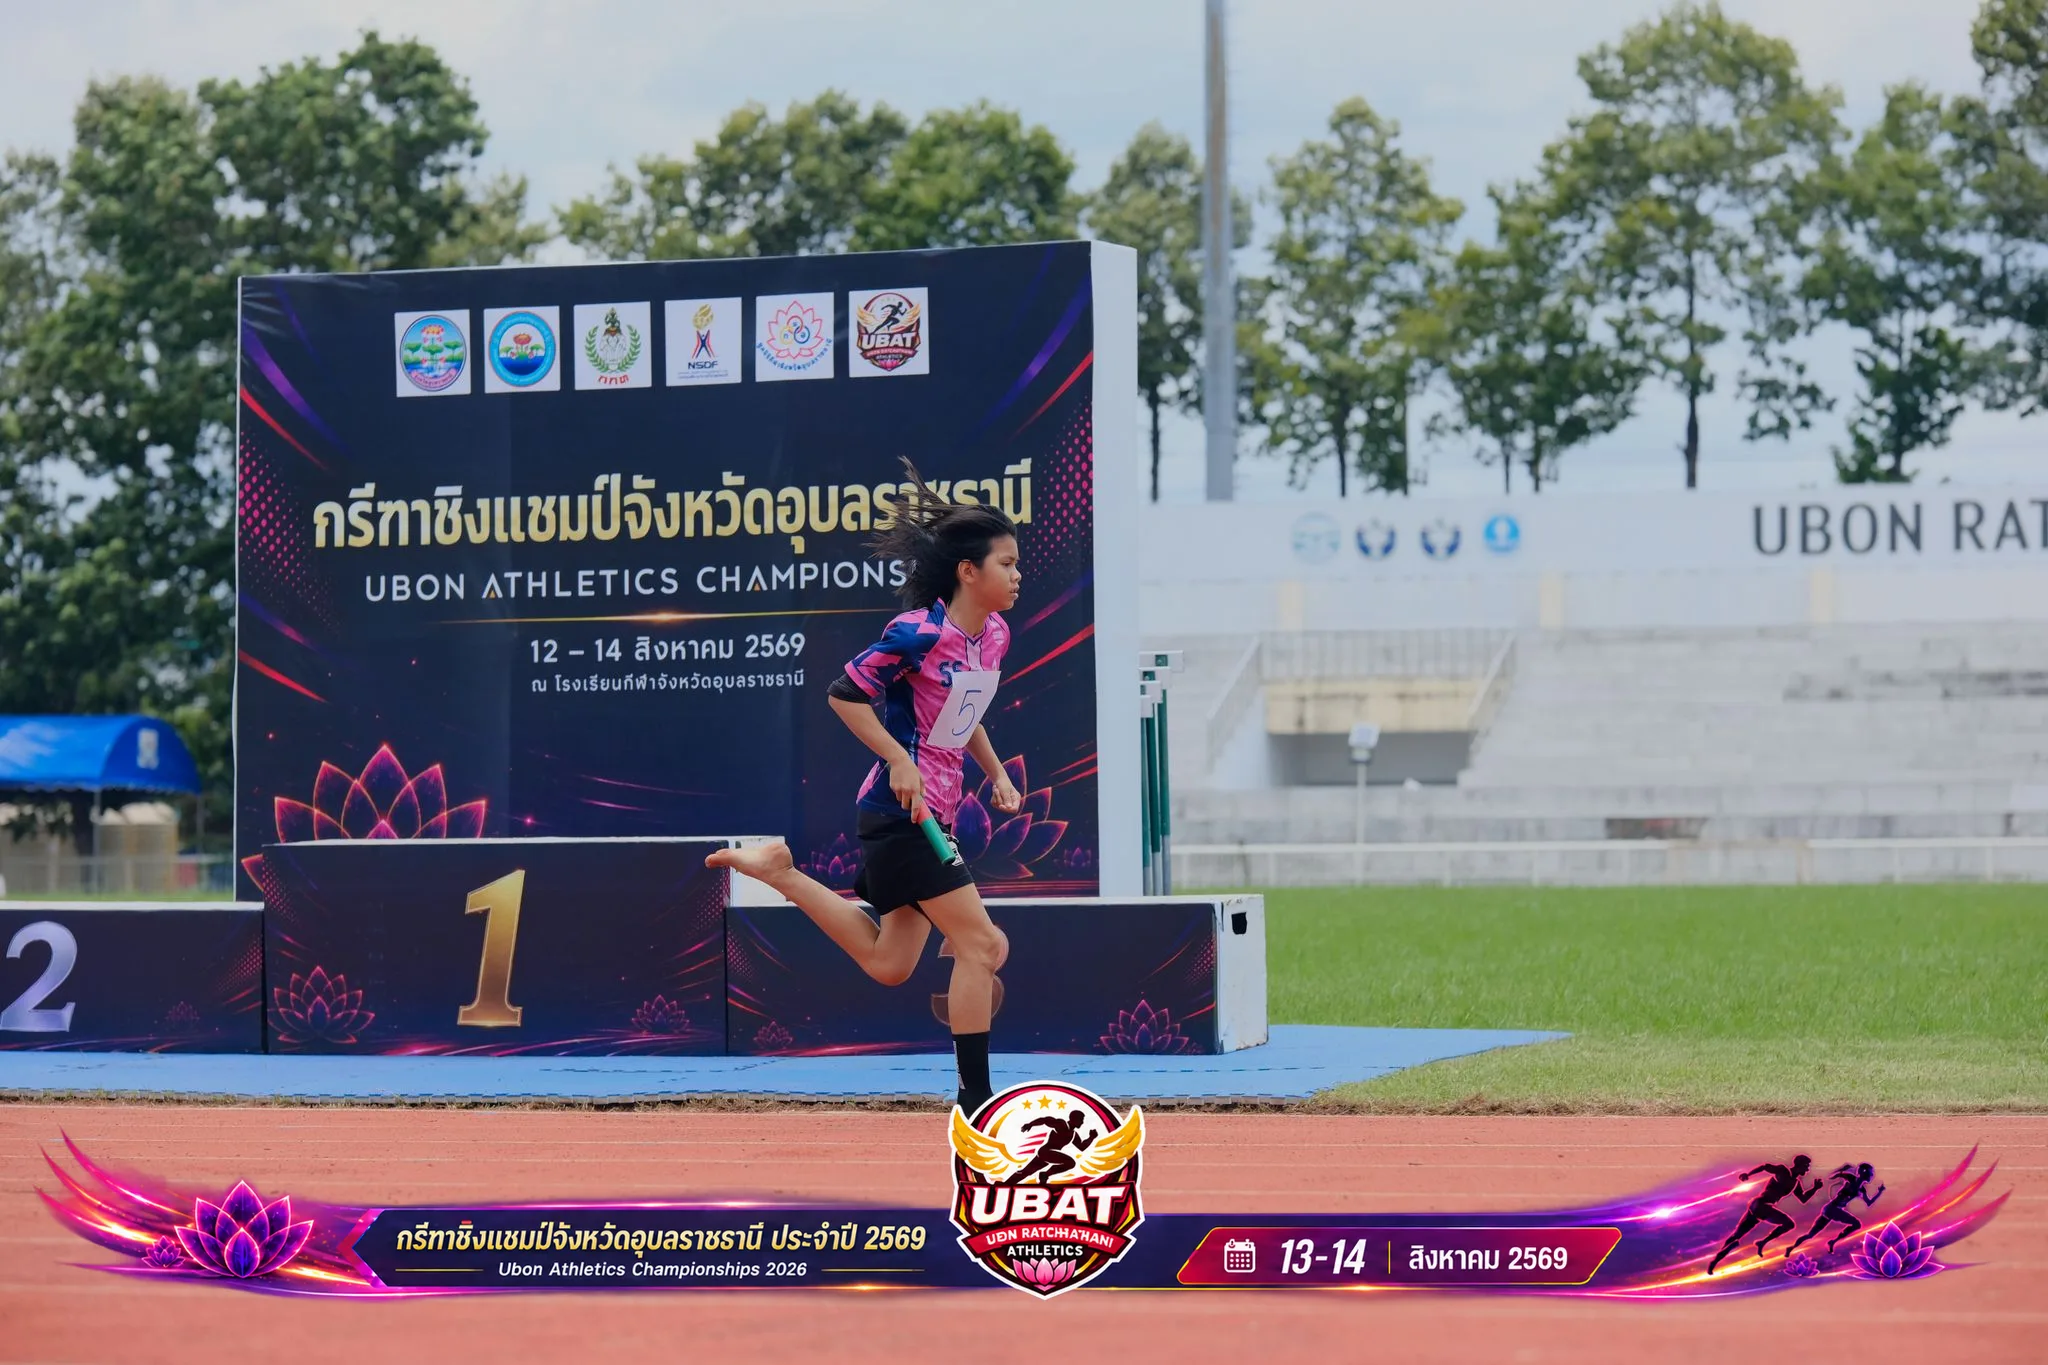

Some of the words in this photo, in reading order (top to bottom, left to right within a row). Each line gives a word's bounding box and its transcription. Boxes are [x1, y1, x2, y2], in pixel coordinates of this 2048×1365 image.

[861, 332, 917, 349] UBAT
[687, 360, 719, 369] NSDF
[1753, 502, 1922, 555] UBON
[365, 573, 465, 601] UBON
[481, 568, 679, 599] ATHLETICS
[696, 559, 907, 593] CHAMPIONS
[530, 639, 558, 664] 12
[594, 638, 622, 662] 14
[634, 636, 734, 661] สิงหาคม
[744, 632, 806, 658] 2569
[531, 679, 548, 692] ณ
[554, 668, 804, 694] โรงเรียนกีฬาจังหวัดอุบลราชธานี
[951, 689, 982, 737] 5
[456, 869, 525, 1028] 1
[0, 920, 79, 1033] 2
